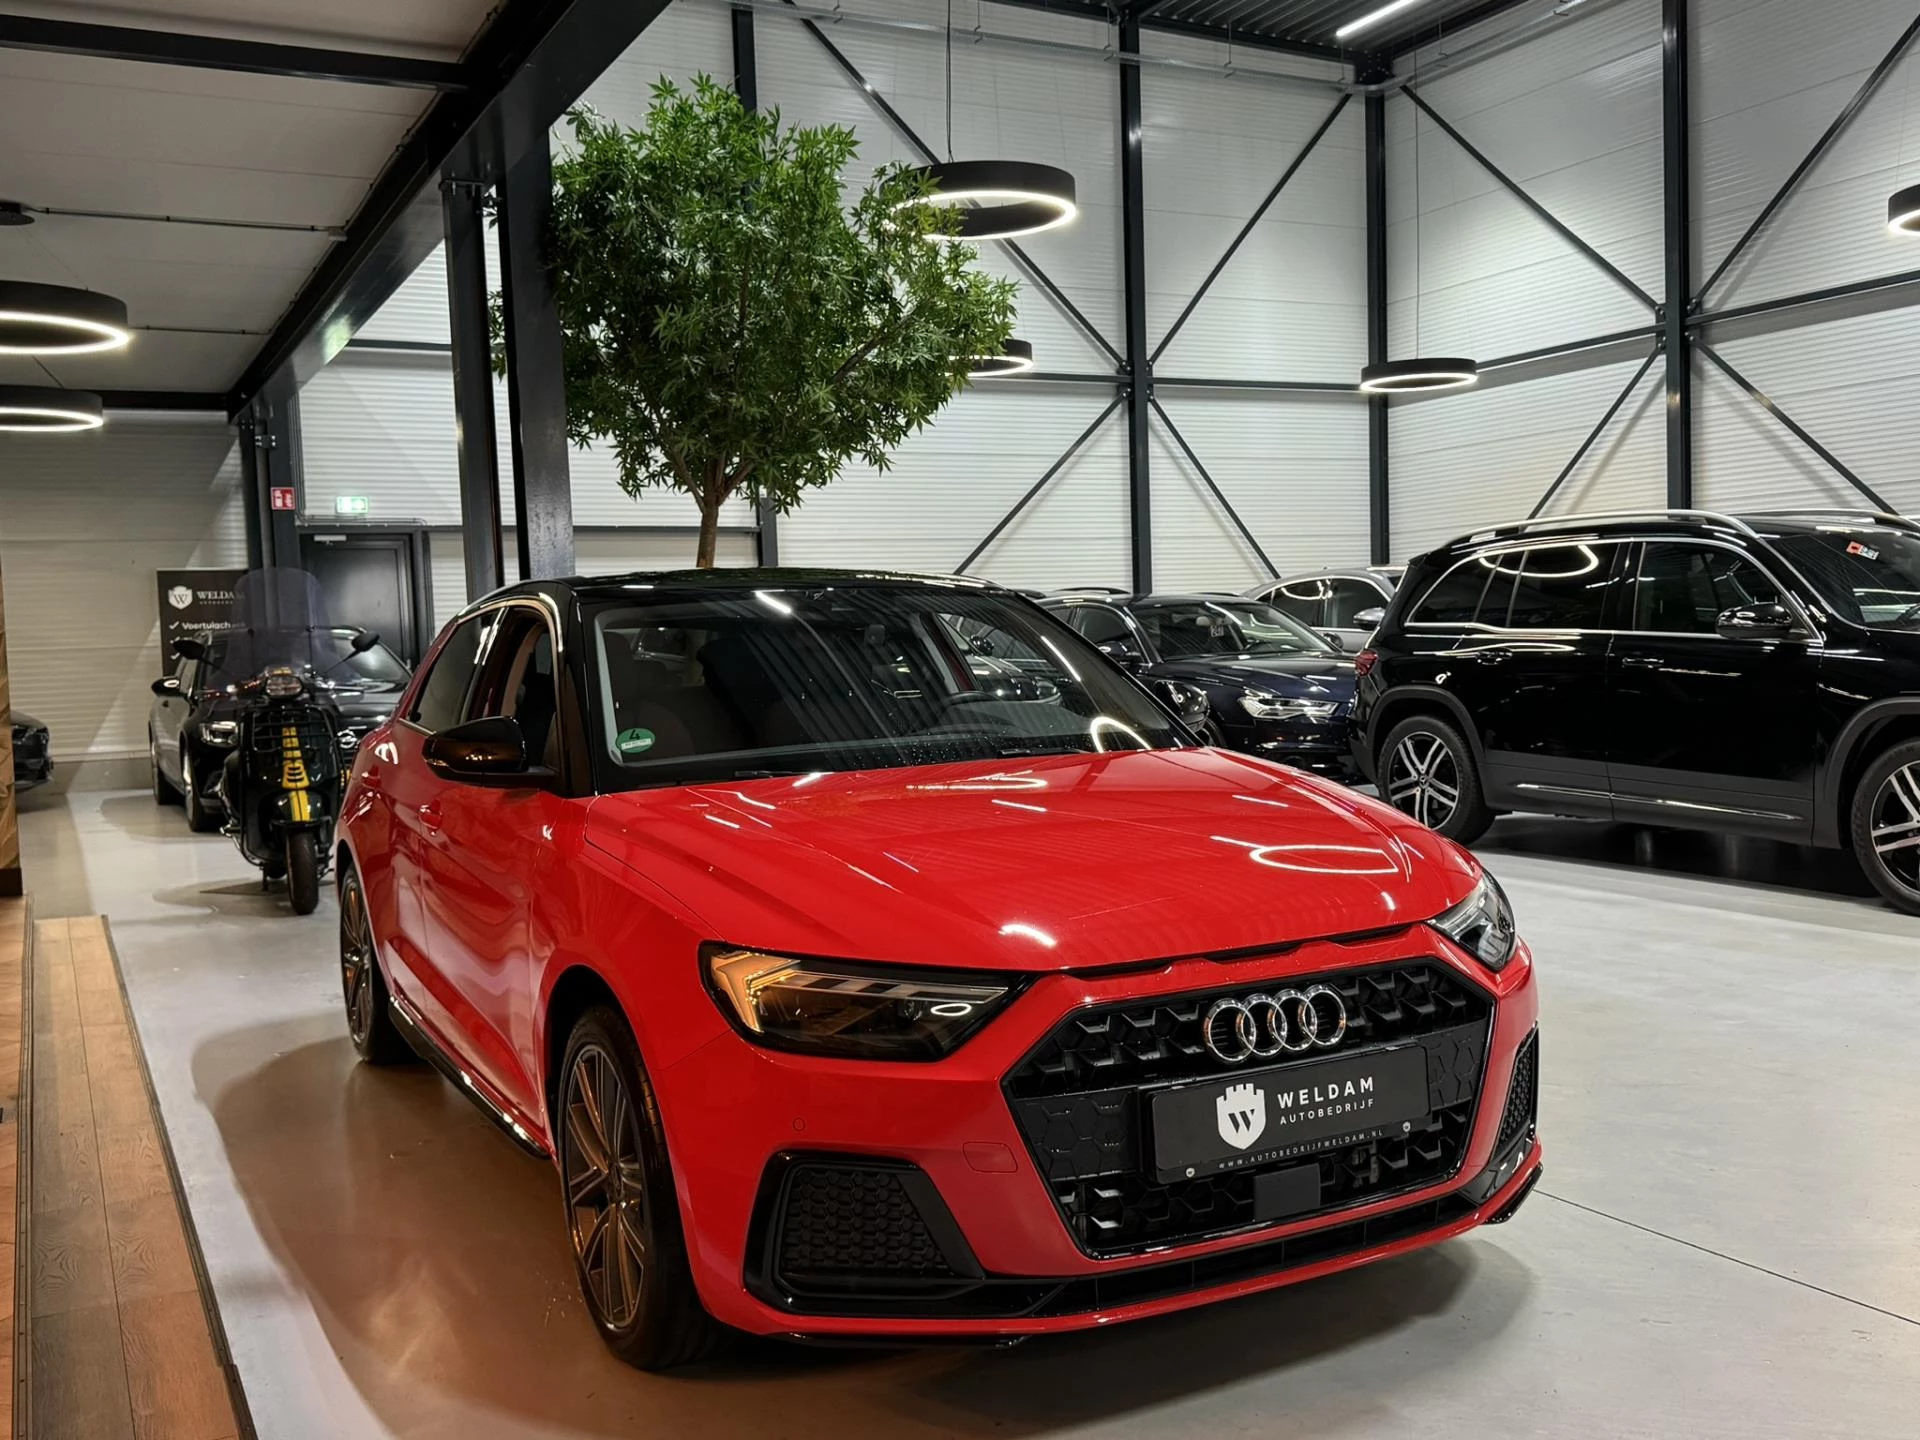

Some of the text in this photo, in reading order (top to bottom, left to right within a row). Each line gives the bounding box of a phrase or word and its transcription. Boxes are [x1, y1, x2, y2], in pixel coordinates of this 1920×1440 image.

[629, 729, 640, 740] 4
[1277, 1077, 1374, 1108] WELDAM
[1228, 1108, 1256, 1134] W
[1280, 1099, 1374, 1125] AUTOBEDRIJF
[1218, 1129, 1384, 1169] WWW.AUTOBEDRIJFWELDAM.NL
